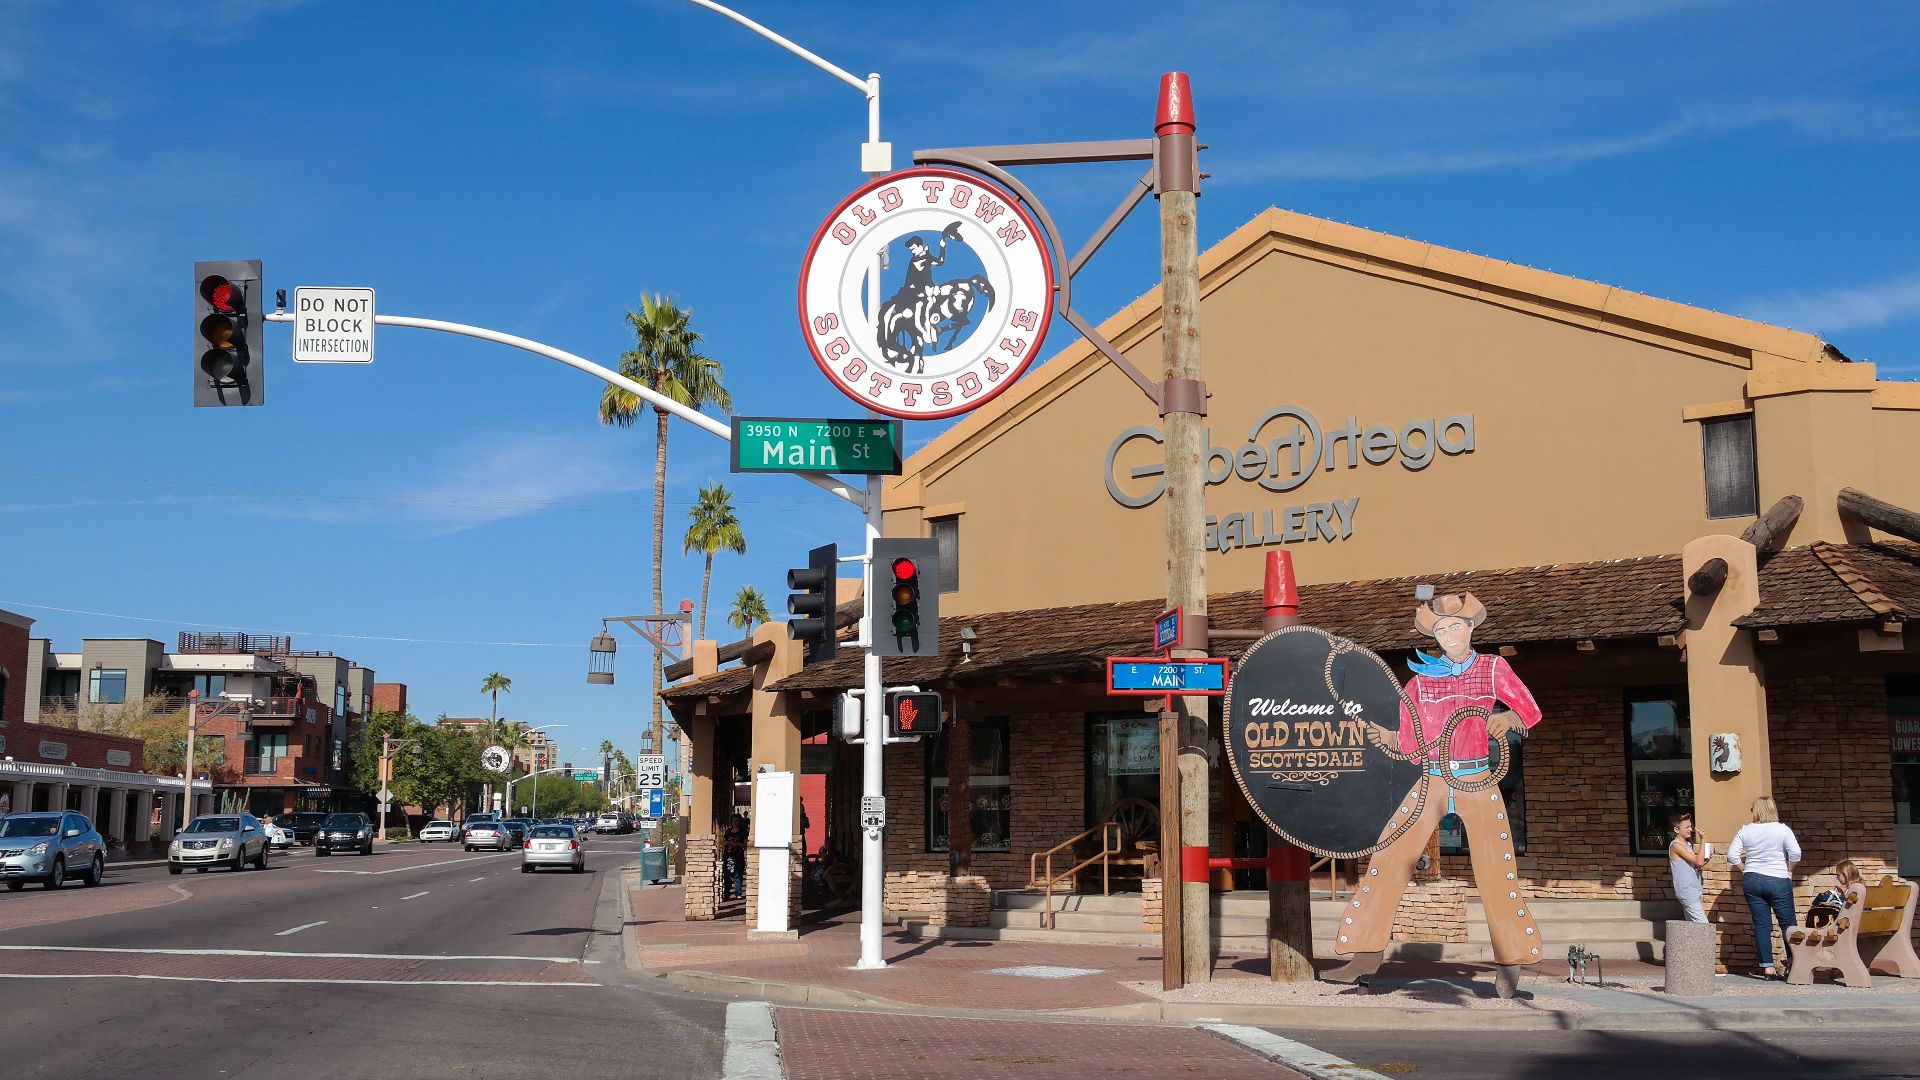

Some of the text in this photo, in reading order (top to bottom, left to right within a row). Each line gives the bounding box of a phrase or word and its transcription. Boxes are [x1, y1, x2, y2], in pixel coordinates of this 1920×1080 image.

[832, 180, 1027, 248] OLD TOWN
[300, 298, 369, 313] DO NOT
[305, 318, 363, 333] BLOCK
[298, 338, 369, 353] INTERSECTION
[814, 308, 1038, 407] SCOTTSDALE
[746, 425, 865, 438] 3950 N 7200 E
[762, 438, 870, 466] Main St
[1131, 666, 1205, 674] E. 7200 ST.
[1151, 674, 1185, 687] MAIN
[1248, 698, 1364, 716] Welcome to
[1244, 720, 1367, 748] OLD TOWN
[1249, 751, 1364, 769] SCOTTSDALE
[639, 773, 662, 786] 25
